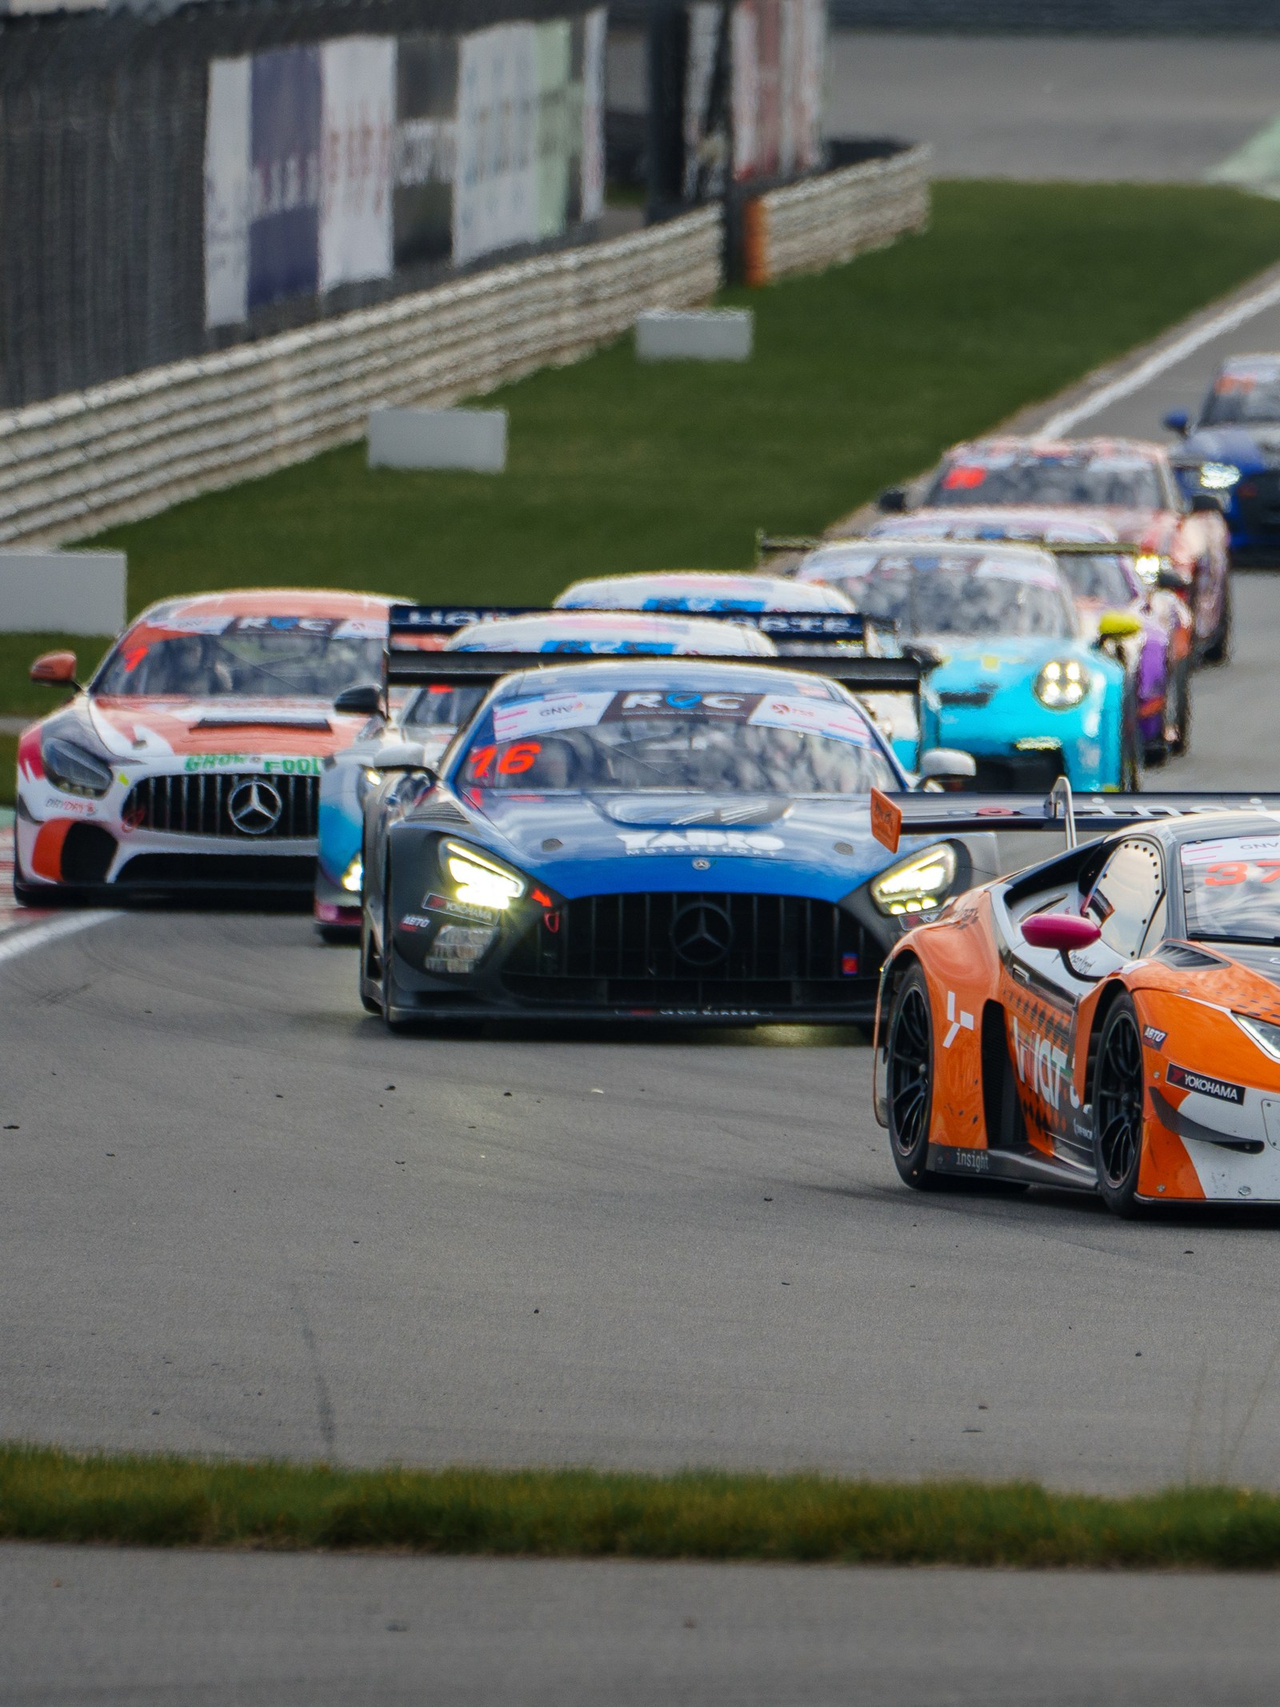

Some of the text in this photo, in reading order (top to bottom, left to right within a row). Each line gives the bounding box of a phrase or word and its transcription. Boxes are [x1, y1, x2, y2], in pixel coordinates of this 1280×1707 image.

[469, 742, 541, 778] 16
[1184, 1073, 1239, 1101] YOKOHAMA
[956, 1148, 989, 1172] insight
